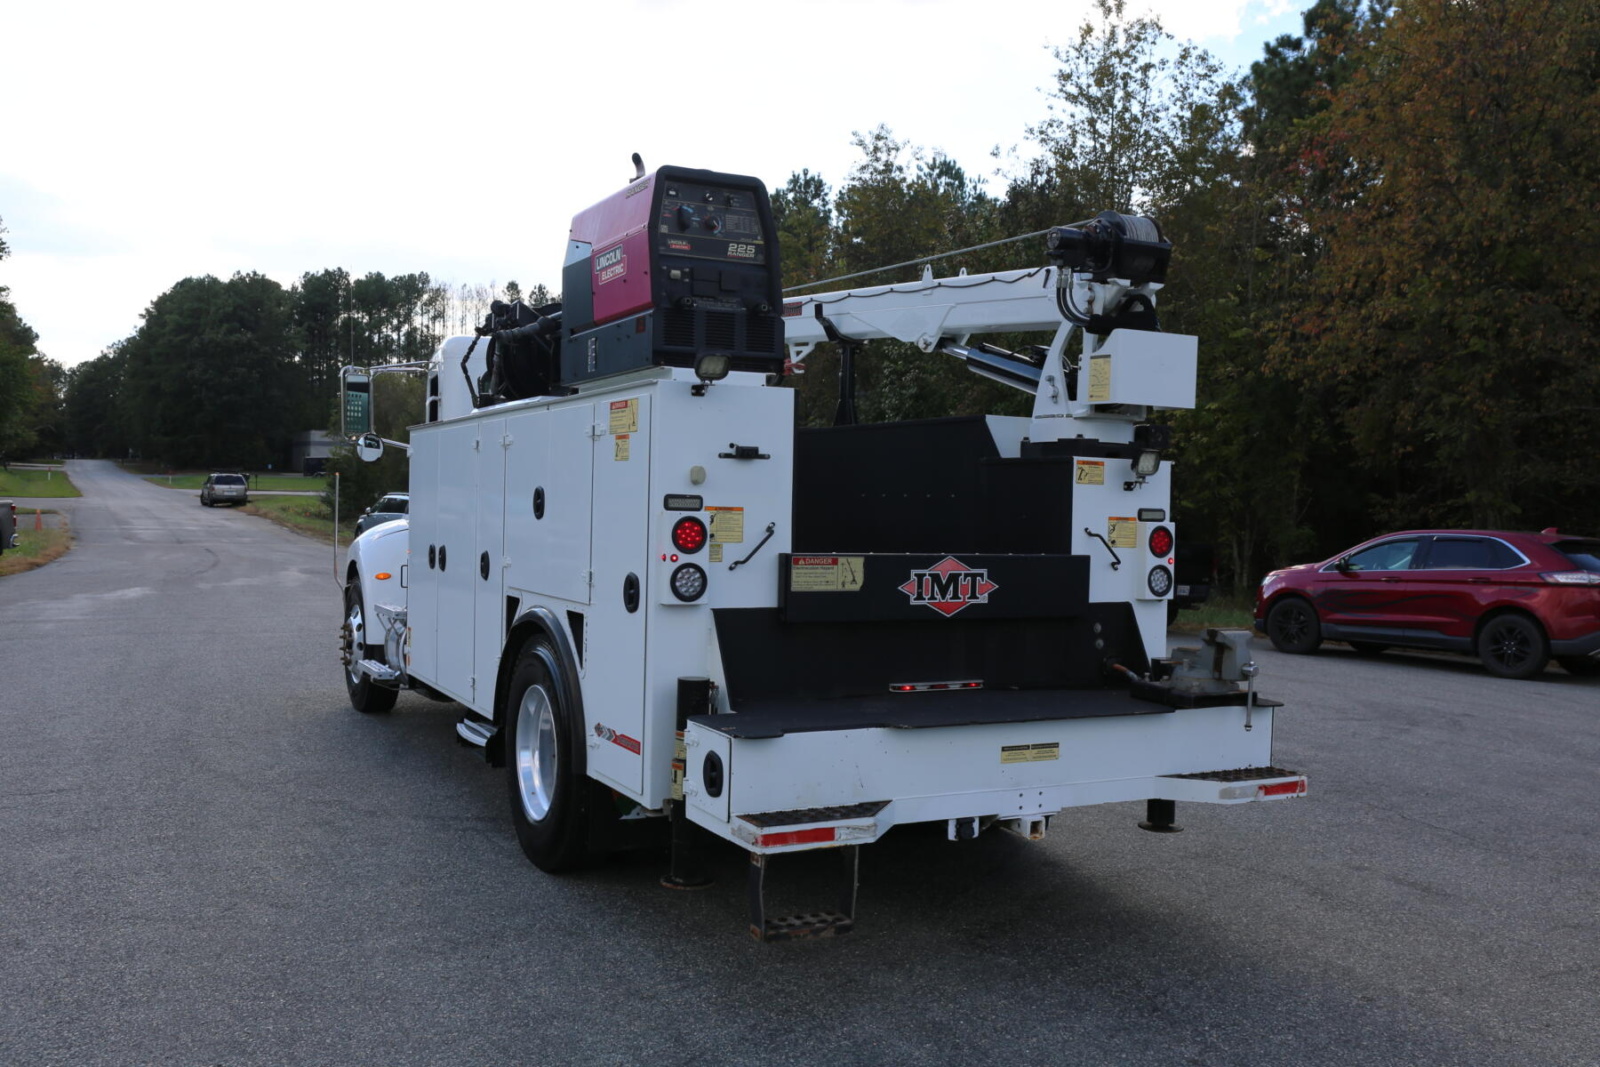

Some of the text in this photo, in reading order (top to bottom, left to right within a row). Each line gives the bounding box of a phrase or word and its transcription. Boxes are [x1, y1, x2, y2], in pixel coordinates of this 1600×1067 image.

[596, 246, 622, 271] LINCOLN
[728, 243, 756, 254] 225
[601, 262, 624, 281] ELECTRIC
[912, 571, 986, 602] IMT
